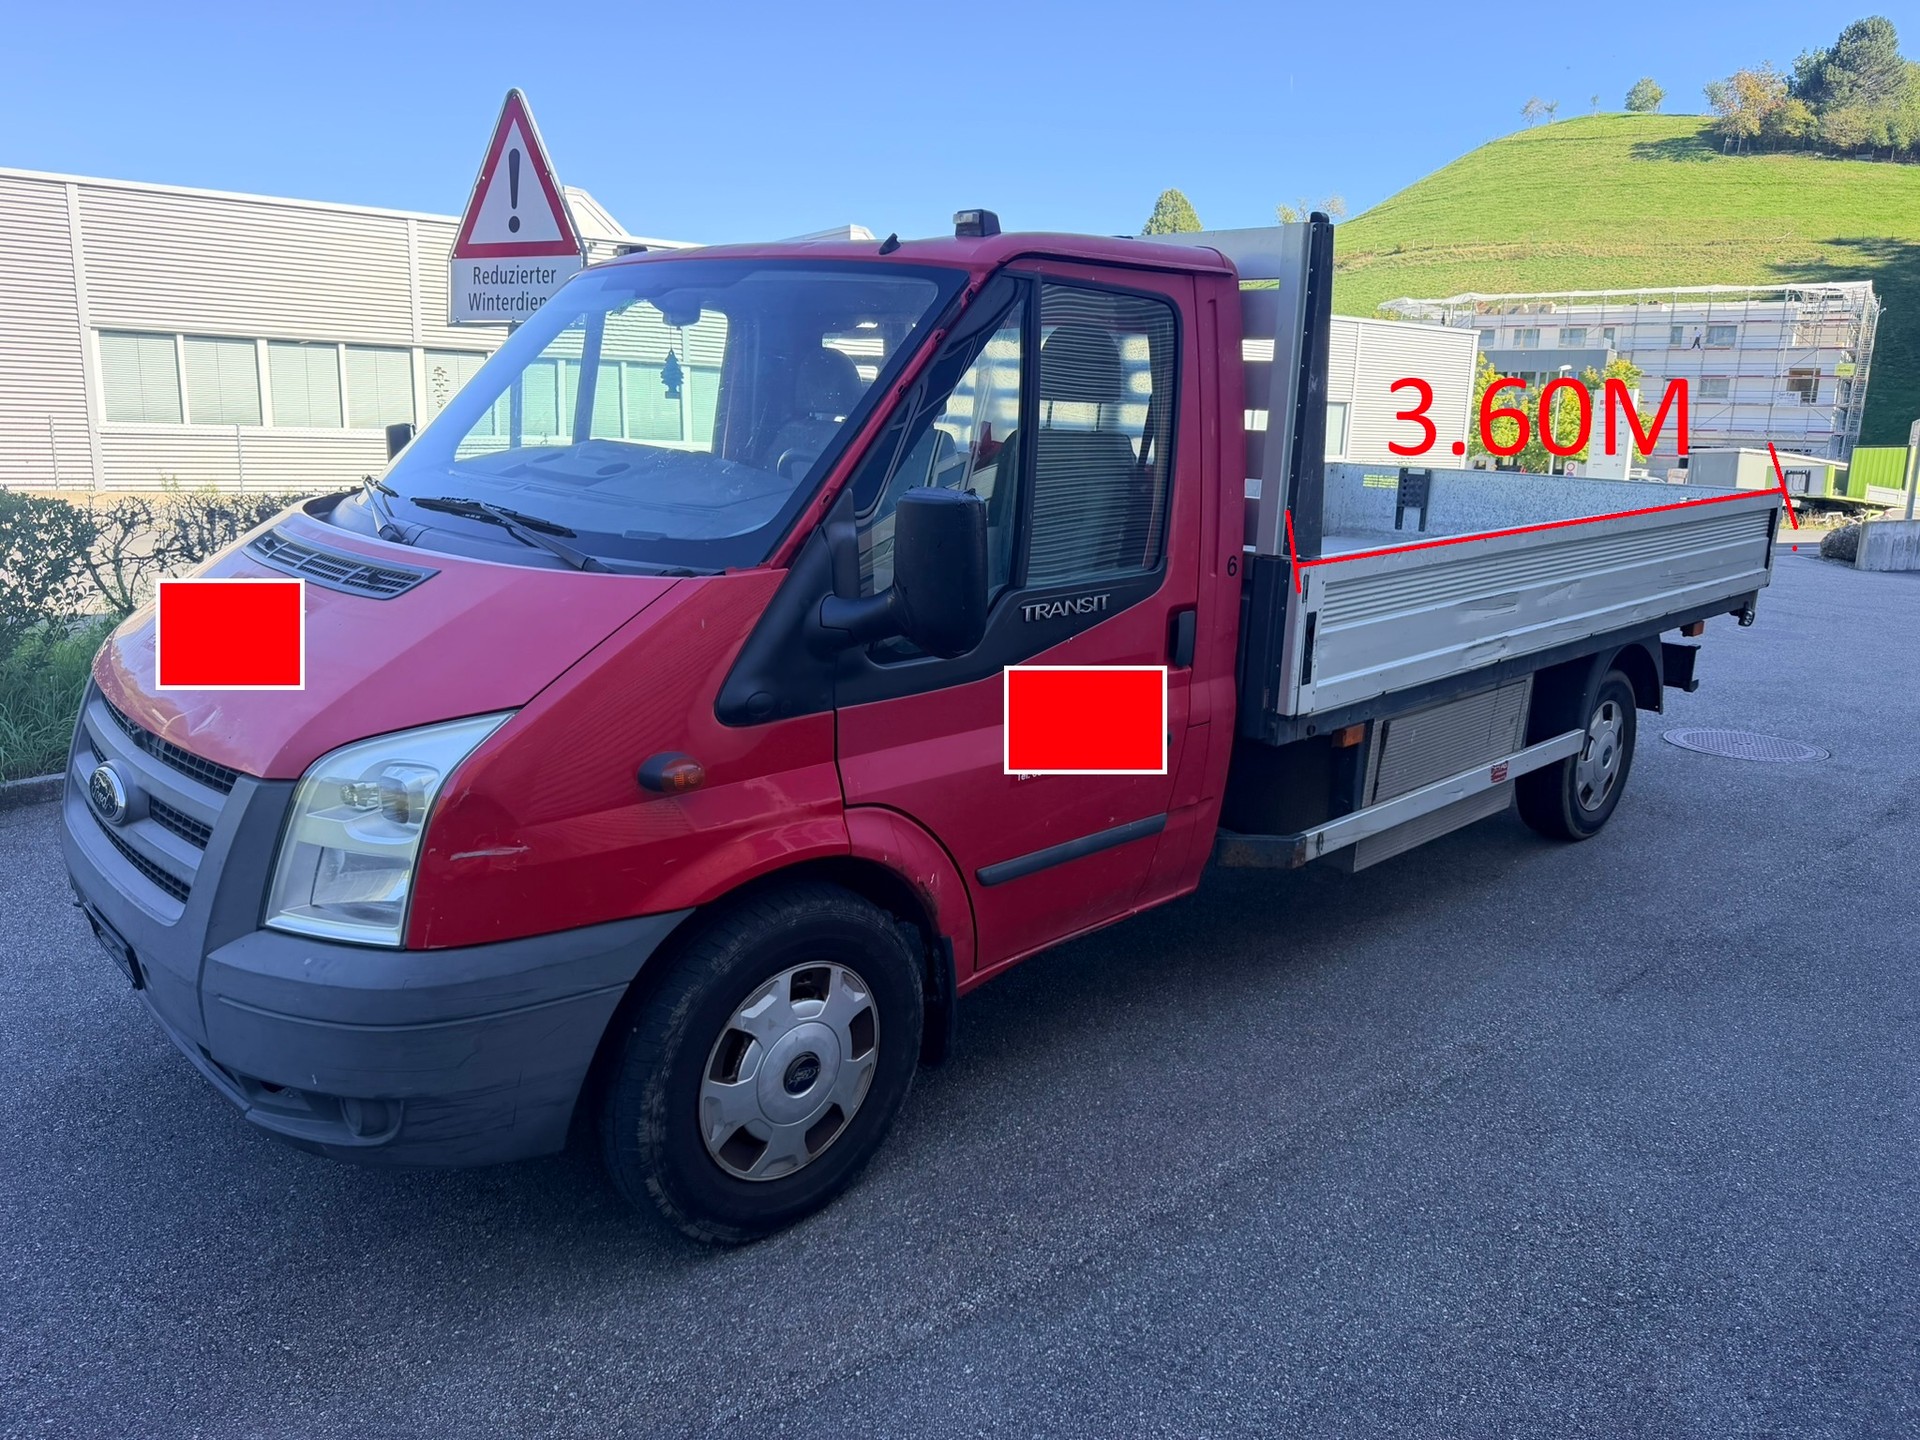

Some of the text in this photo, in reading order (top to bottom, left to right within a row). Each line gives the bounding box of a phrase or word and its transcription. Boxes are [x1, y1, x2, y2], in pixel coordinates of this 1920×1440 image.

[473, 265, 557, 285] Reduzierter
[1227, 555, 1238, 577] 6
[1021, 594, 1111, 623] TRANSIT
